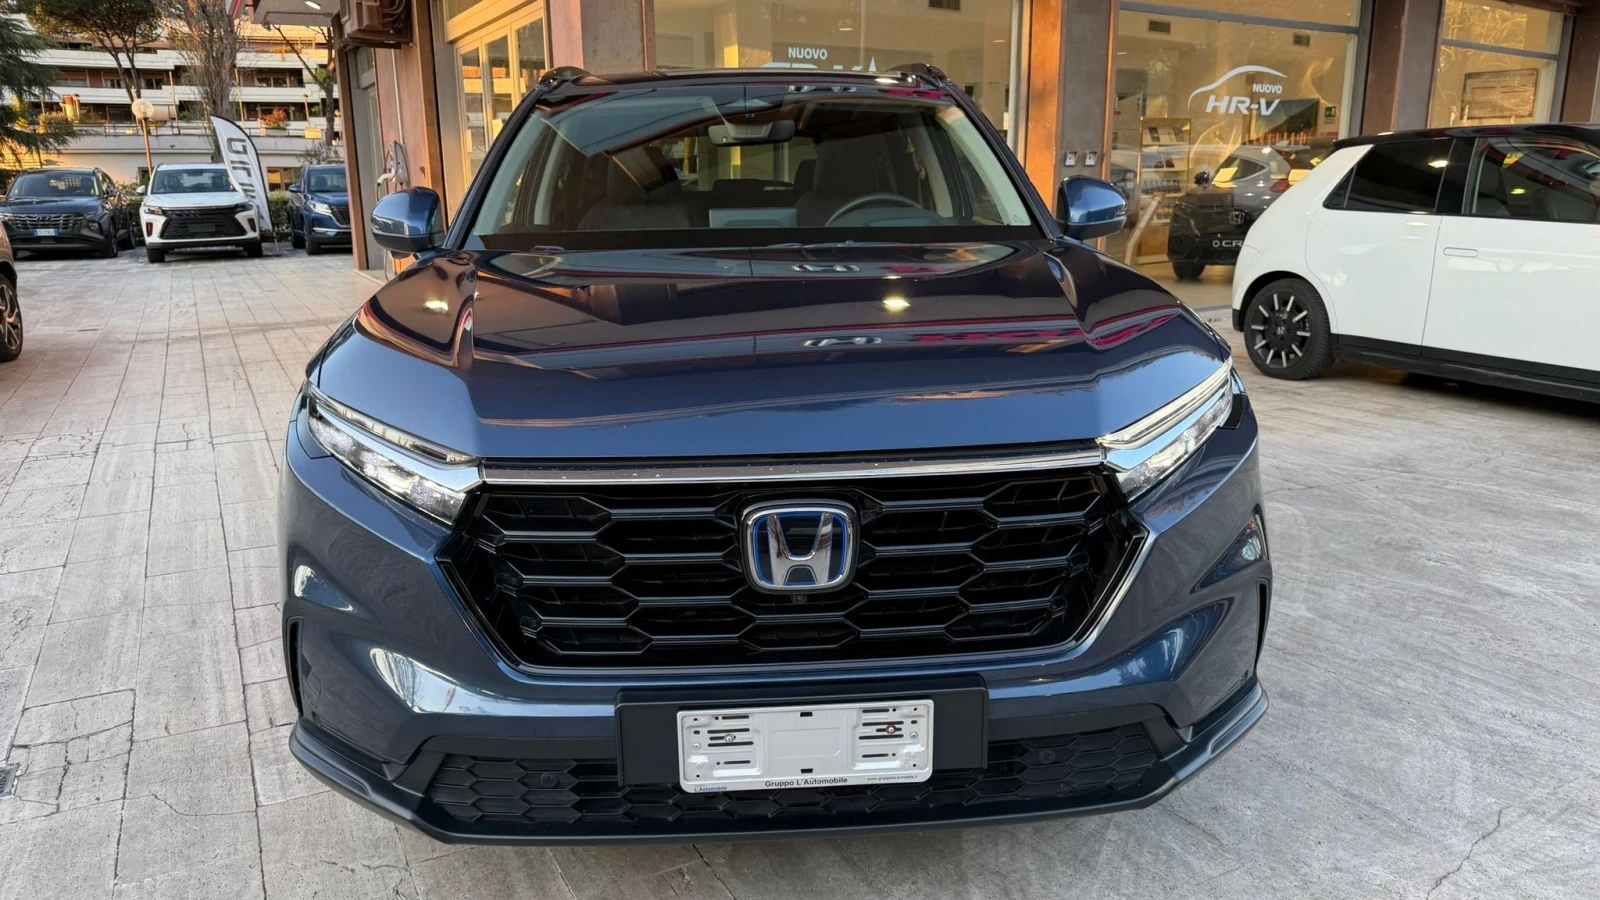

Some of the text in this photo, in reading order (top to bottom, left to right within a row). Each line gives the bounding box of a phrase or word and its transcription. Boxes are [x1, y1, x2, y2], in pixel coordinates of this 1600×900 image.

[788, 47, 828, 60] NUOVO
[1252, 83, 1283, 94] NUOVO
[1205, 94, 1281, 116] HR-V
[764, 777, 848, 788] Gruppo L'Automobile
